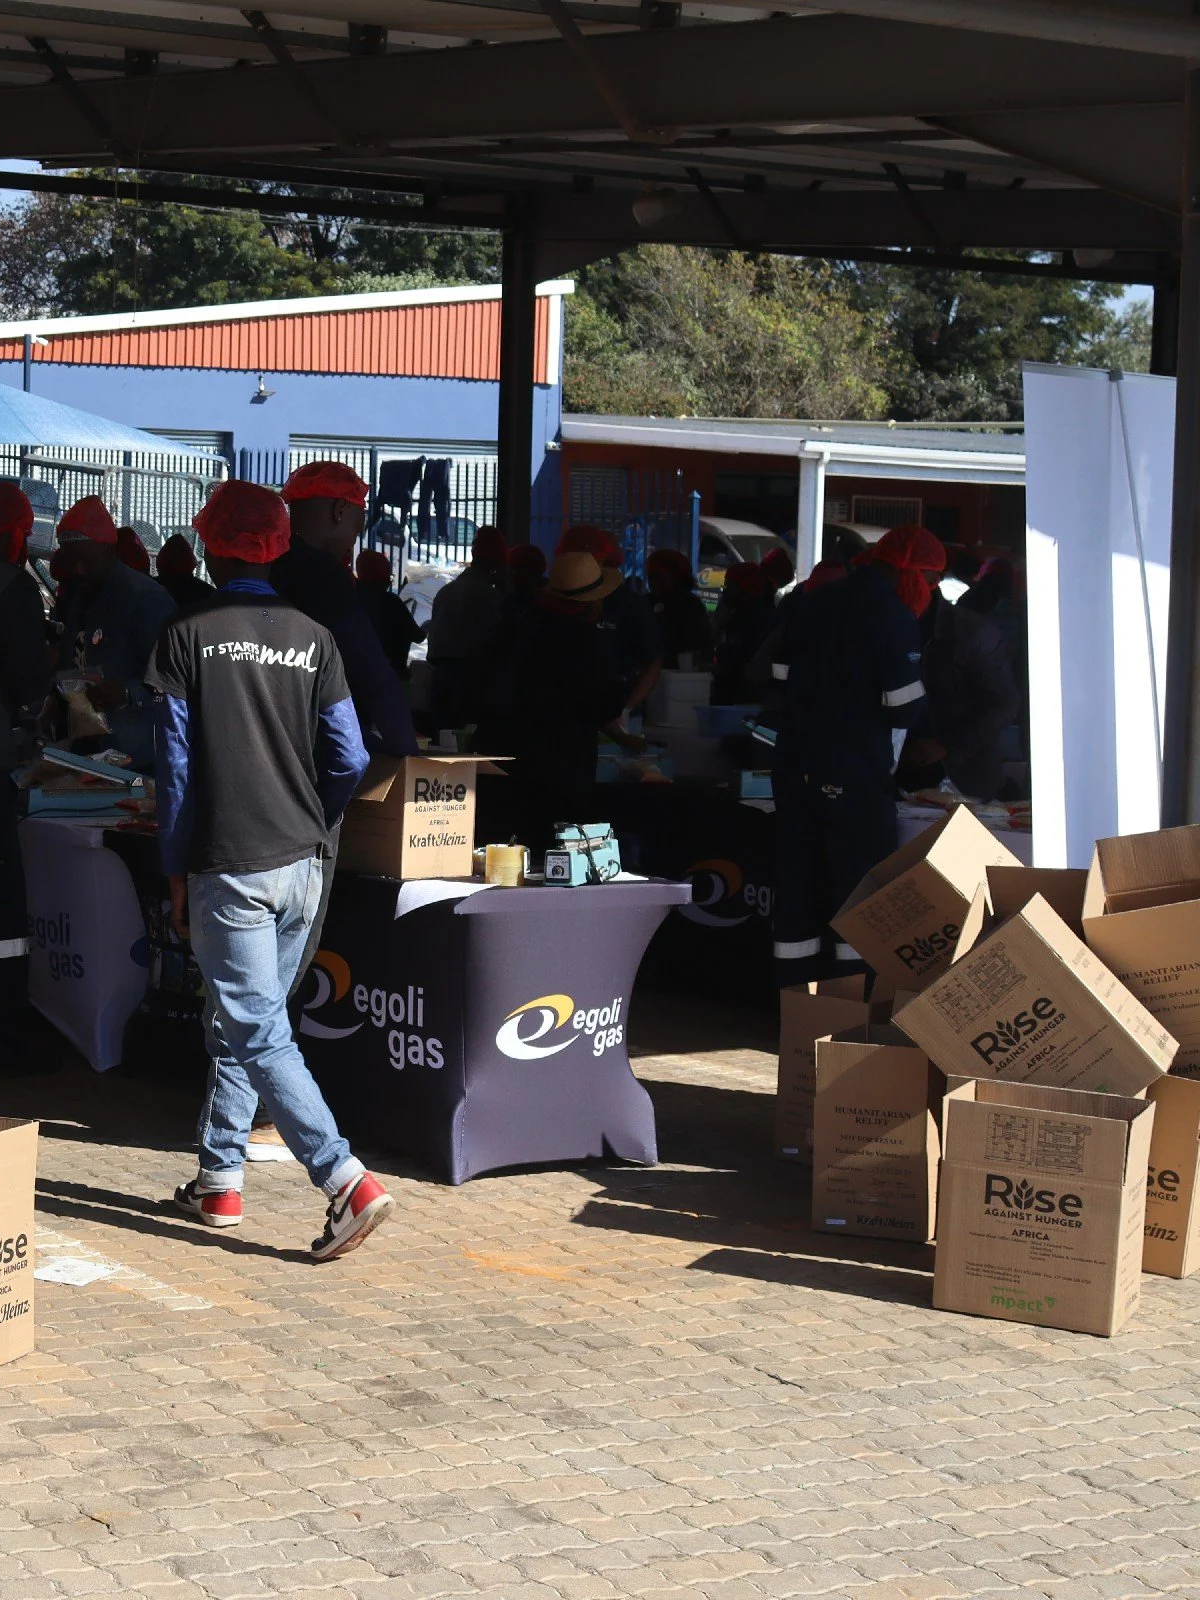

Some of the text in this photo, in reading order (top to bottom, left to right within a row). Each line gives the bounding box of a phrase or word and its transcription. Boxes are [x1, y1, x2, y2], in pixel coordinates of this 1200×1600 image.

[202, 641, 259, 658] IT STARTS
[230, 652, 255, 662] WITH
[259, 641, 318, 673] meal
[414, 804, 467, 813] AGAINST HUNGER
[49, 949, 85, 981] gas
[1143, 973, 1180, 985] RELIEF
[353, 984, 424, 1028] egoli
[572, 997, 623, 1035] egoli
[388, 1029, 445, 1070] gas
[592, 1024, 623, 1057] gas
[994, 1042, 1030, 1074] AGAINST
[1029, 1012, 1067, 1044] HUNGER
[1026, 1044, 1057, 1070] AFRICA
[834, 1105, 911, 1120] HUMANITARIAN
[855, 1116, 890, 1127] RELIEF
[857, 1135, 873, 1143] FOR
[875, 1137, 905, 1146] RESALE
[984, 1207, 1083, 1229] AGAINST HUNGER
[1011, 1229, 1050, 1242] AFRICA
[3, 1259, 28, 1276] HUNGER
[989, 1294, 1043, 1313] mpact
